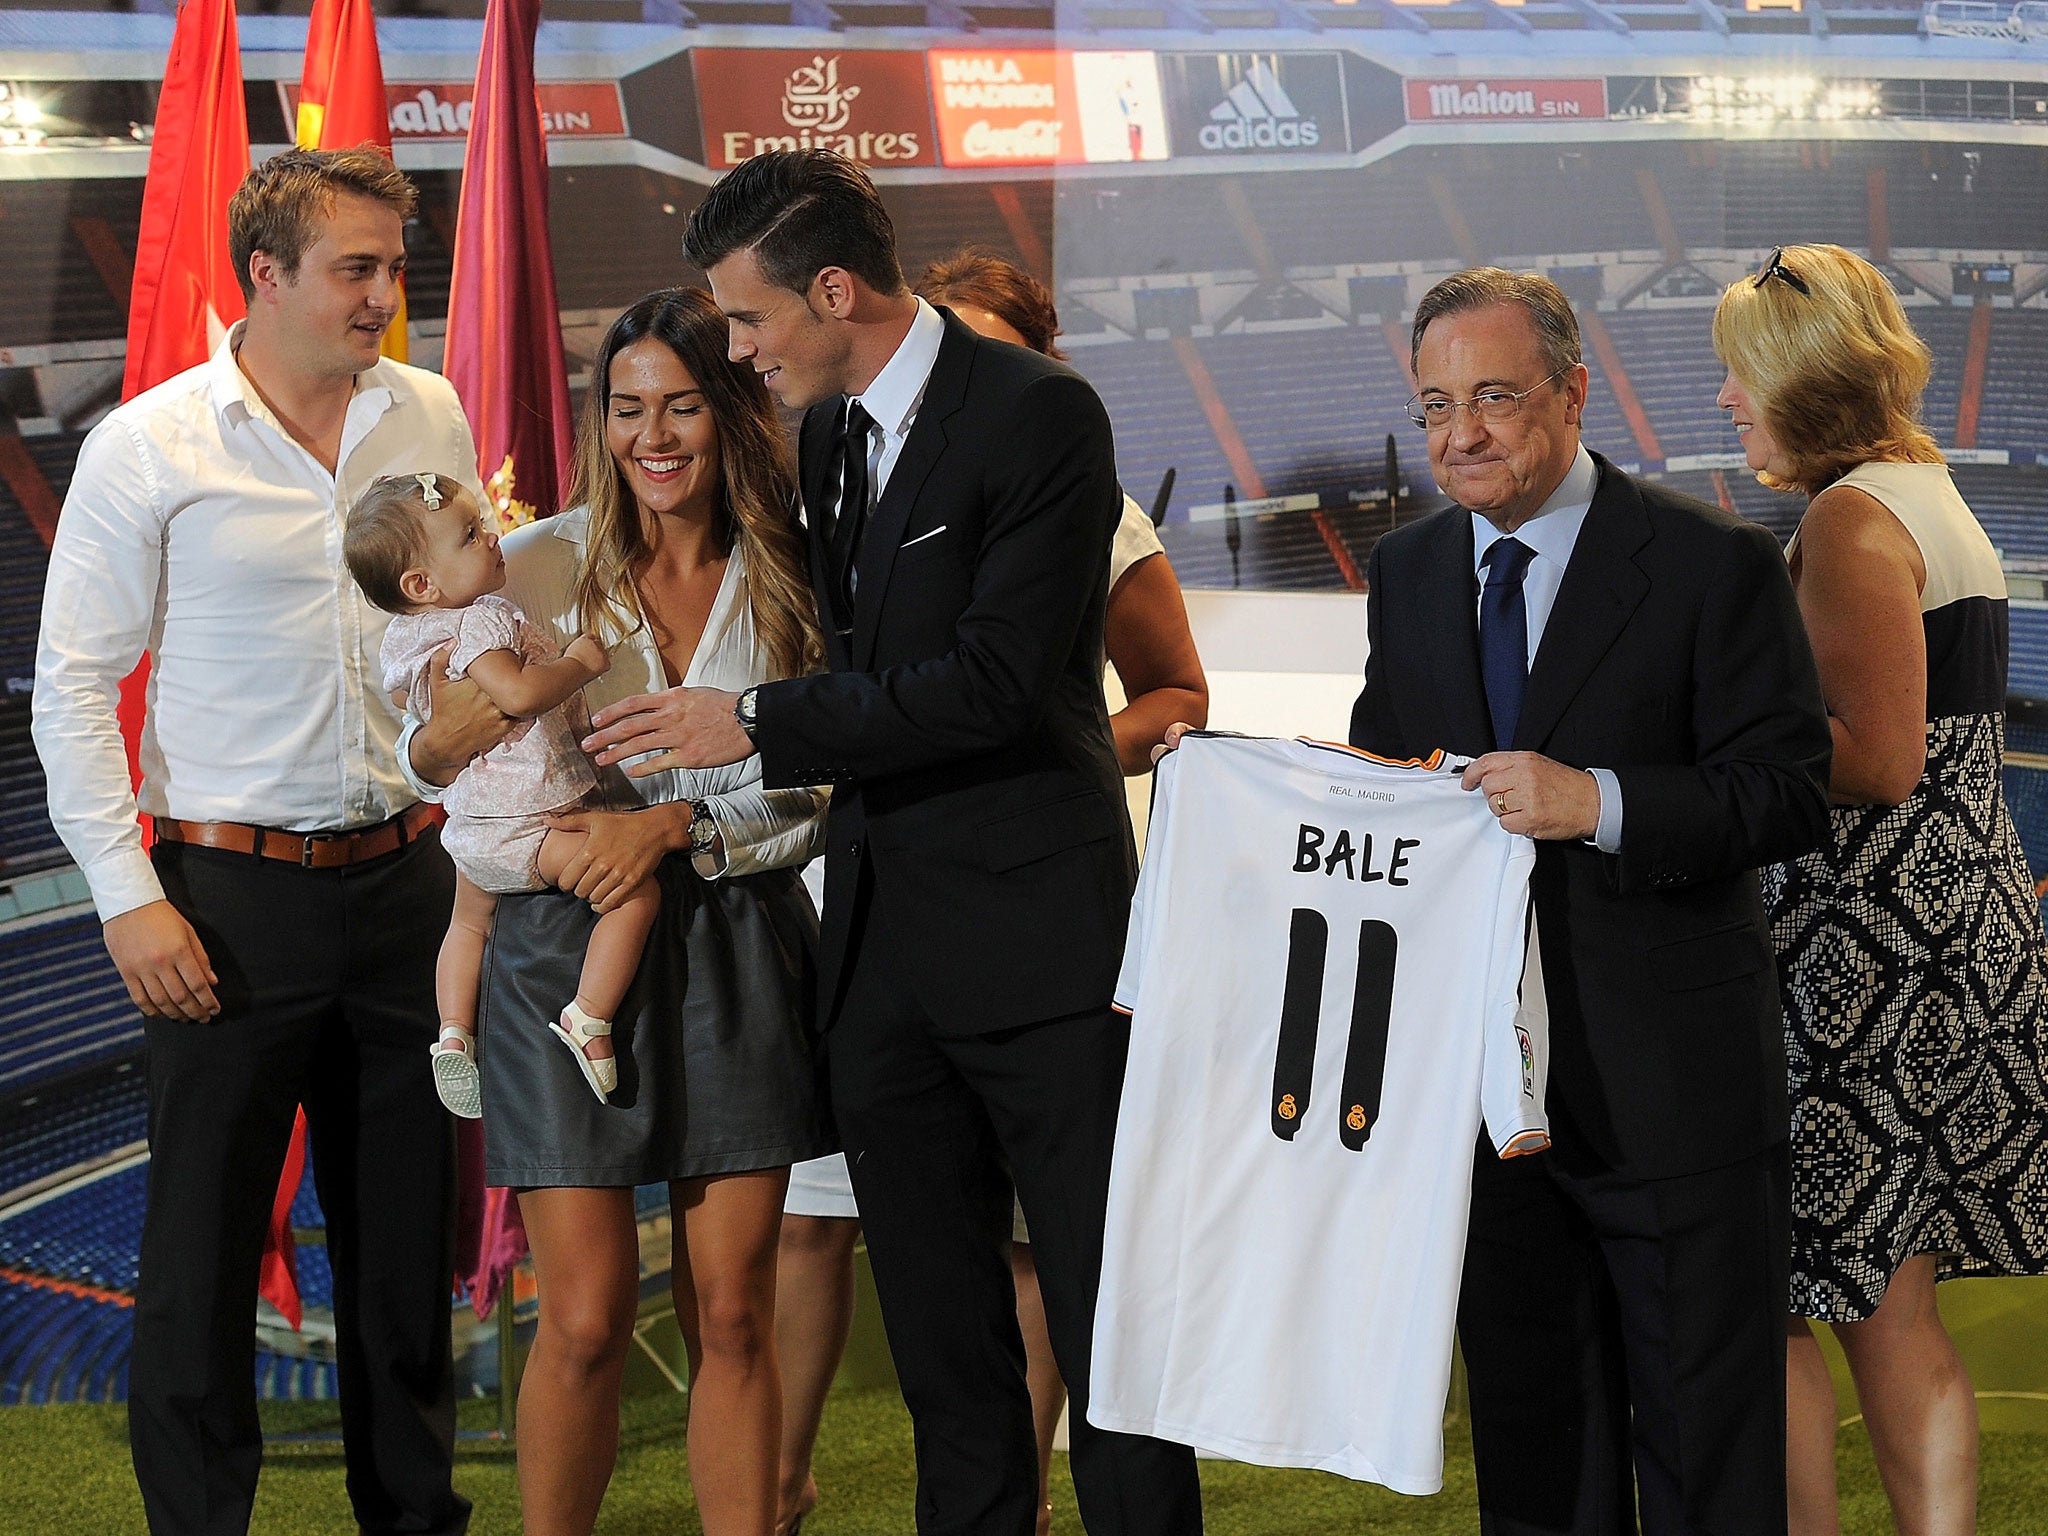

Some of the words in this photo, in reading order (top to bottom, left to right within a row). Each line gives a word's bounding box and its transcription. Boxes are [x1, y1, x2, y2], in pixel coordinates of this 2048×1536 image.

[1429, 82, 1535, 116] Mahou
[1541, 101, 1580, 116] SIN
[1199, 115, 1319, 149] adidas
[1329, 785, 1353, 798] REAL
[1357, 789, 1396, 803] MADRID
[1292, 823, 1421, 887] BALE
[1271, 908, 1398, 1152] 11
